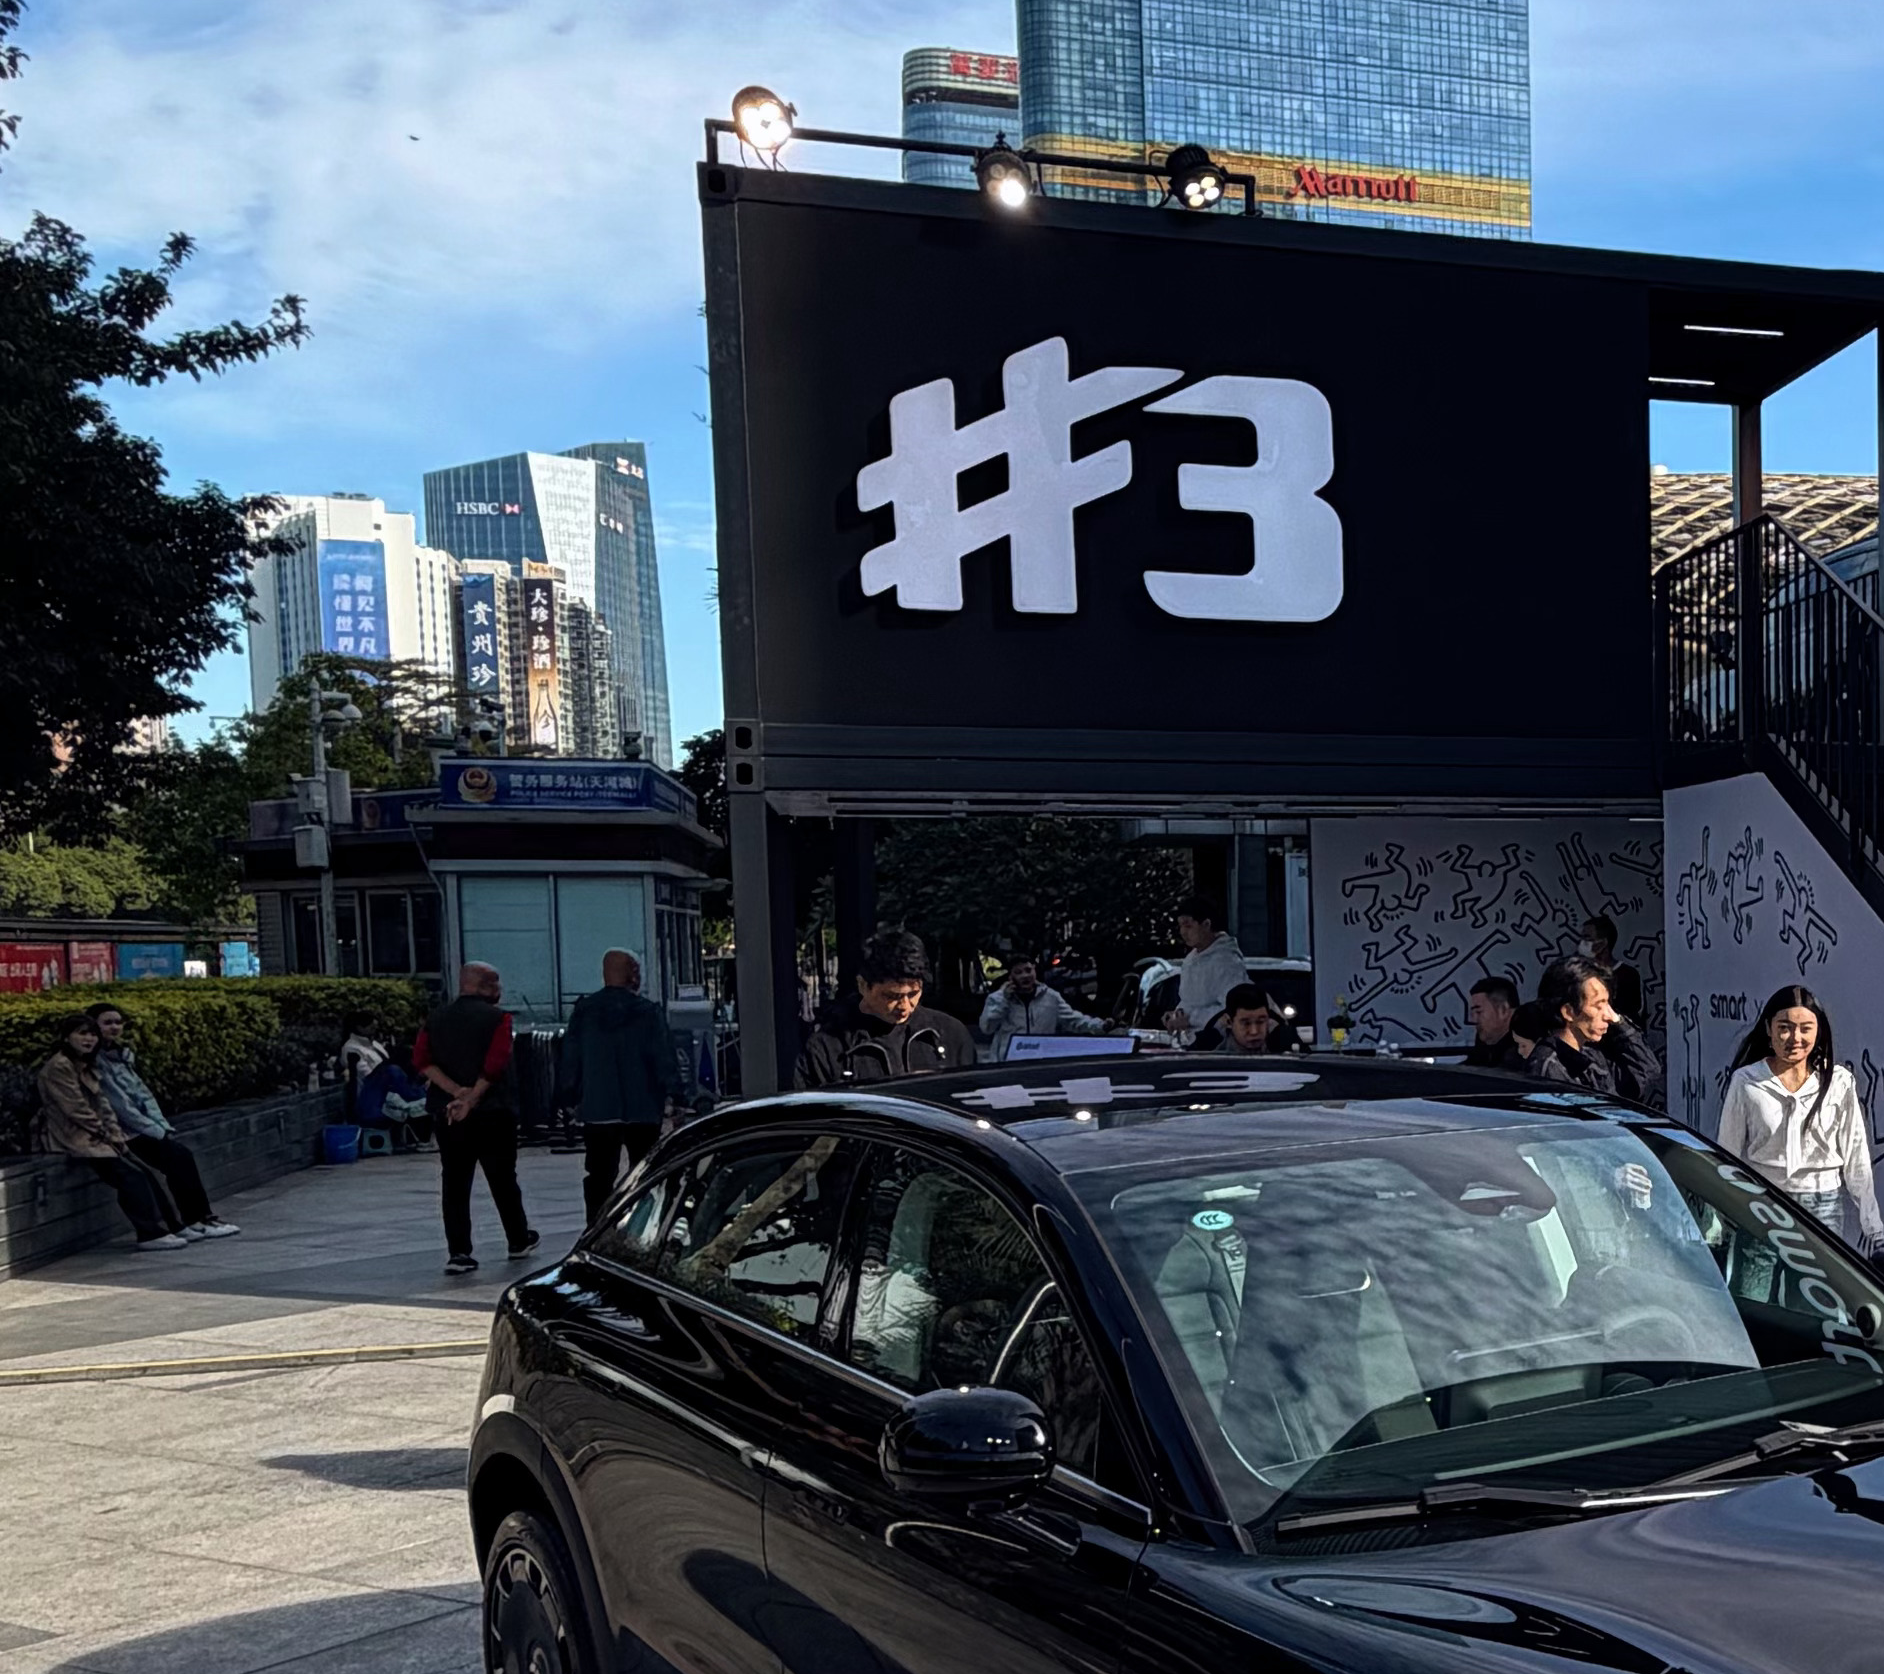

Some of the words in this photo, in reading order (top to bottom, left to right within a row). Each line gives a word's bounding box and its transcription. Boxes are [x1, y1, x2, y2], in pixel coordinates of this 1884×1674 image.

[1284, 163, 1418, 202] Marriott
[856, 335, 1344, 623] #3
[455, 502, 500, 516] HSBC
[1709, 992, 1748, 1022] smart
